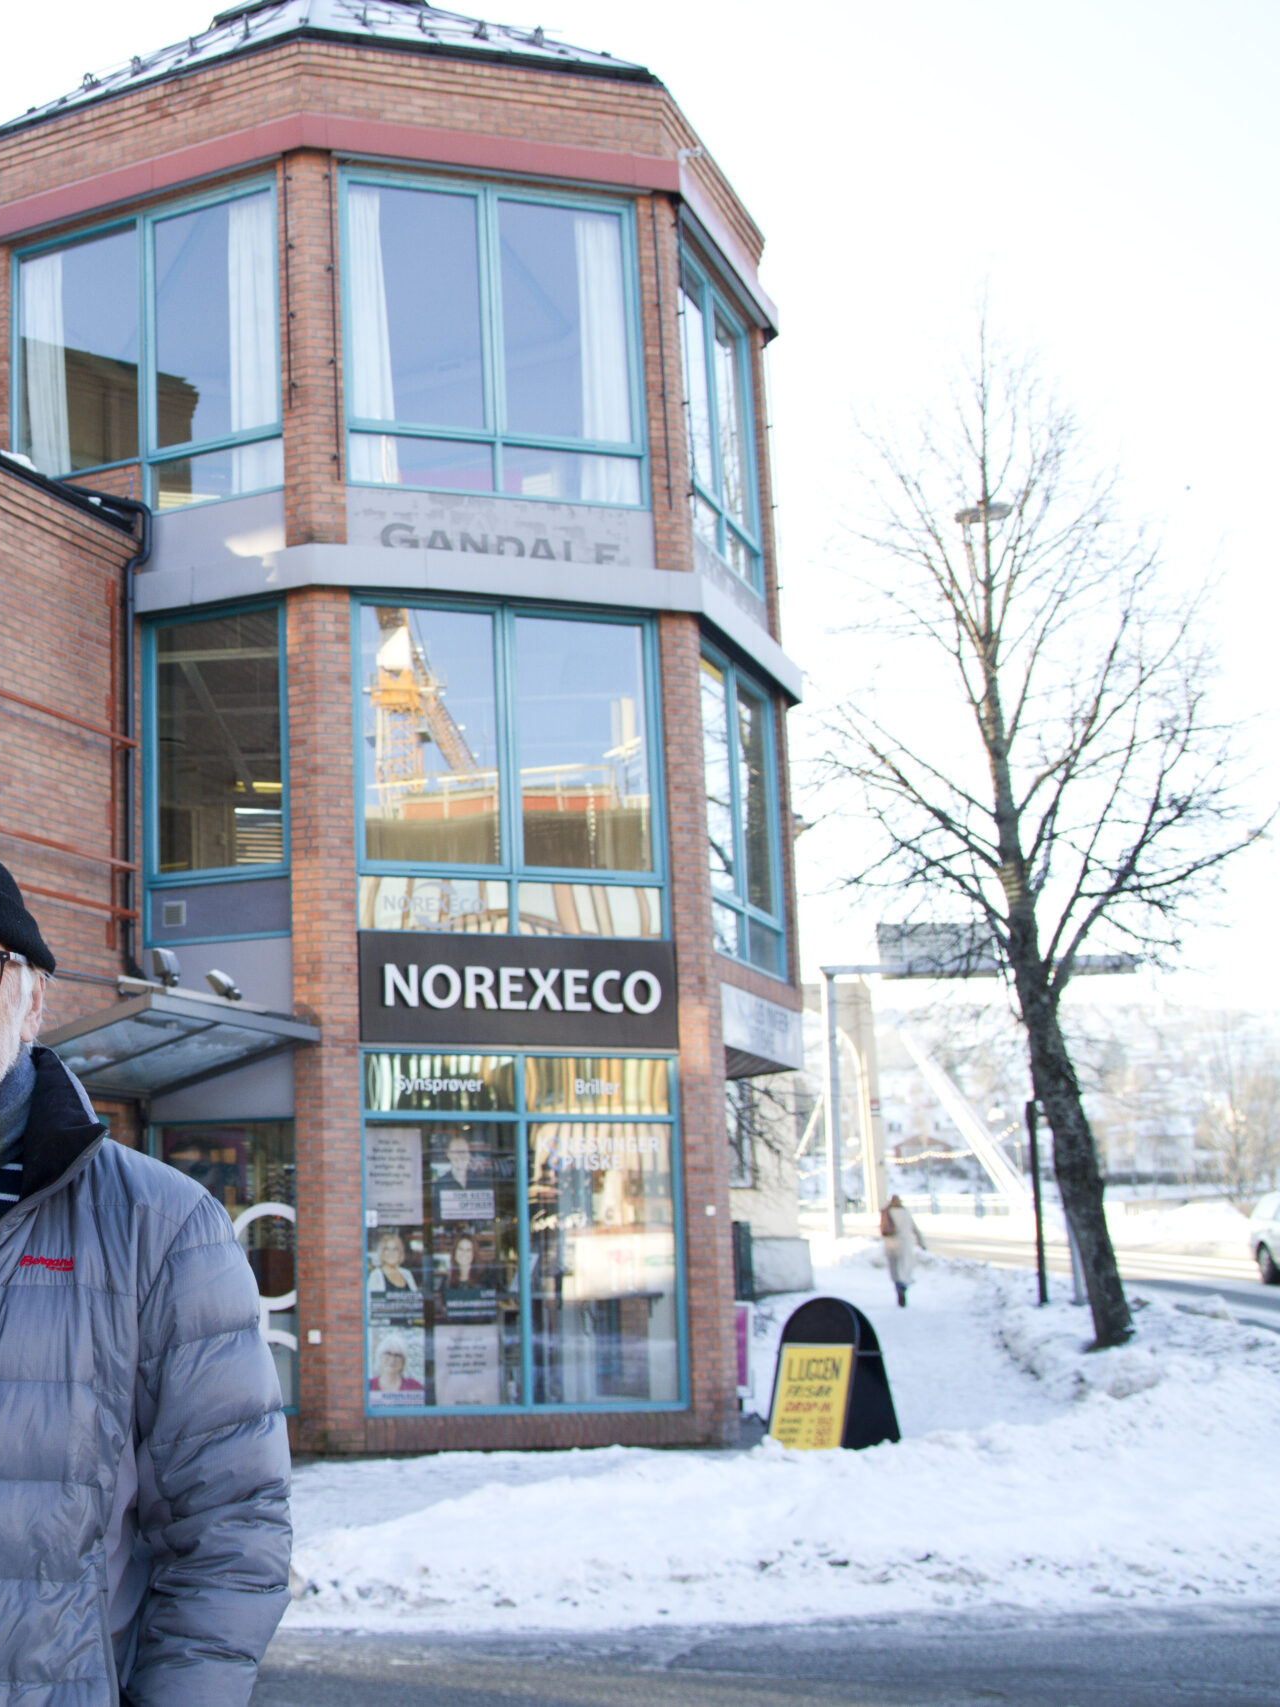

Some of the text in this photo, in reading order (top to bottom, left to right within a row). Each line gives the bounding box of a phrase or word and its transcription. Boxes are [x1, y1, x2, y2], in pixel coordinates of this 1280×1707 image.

[383, 892, 486, 915] NOREXECO
[383, 962, 663, 1015] NOREXECO
[395, 1074, 484, 1095] Synsprøver
[574, 1079, 621, 1096] Briller
[536, 1136, 660, 1155] KONGSVINGER
[547, 1151, 622, 1171] OPTISKE
